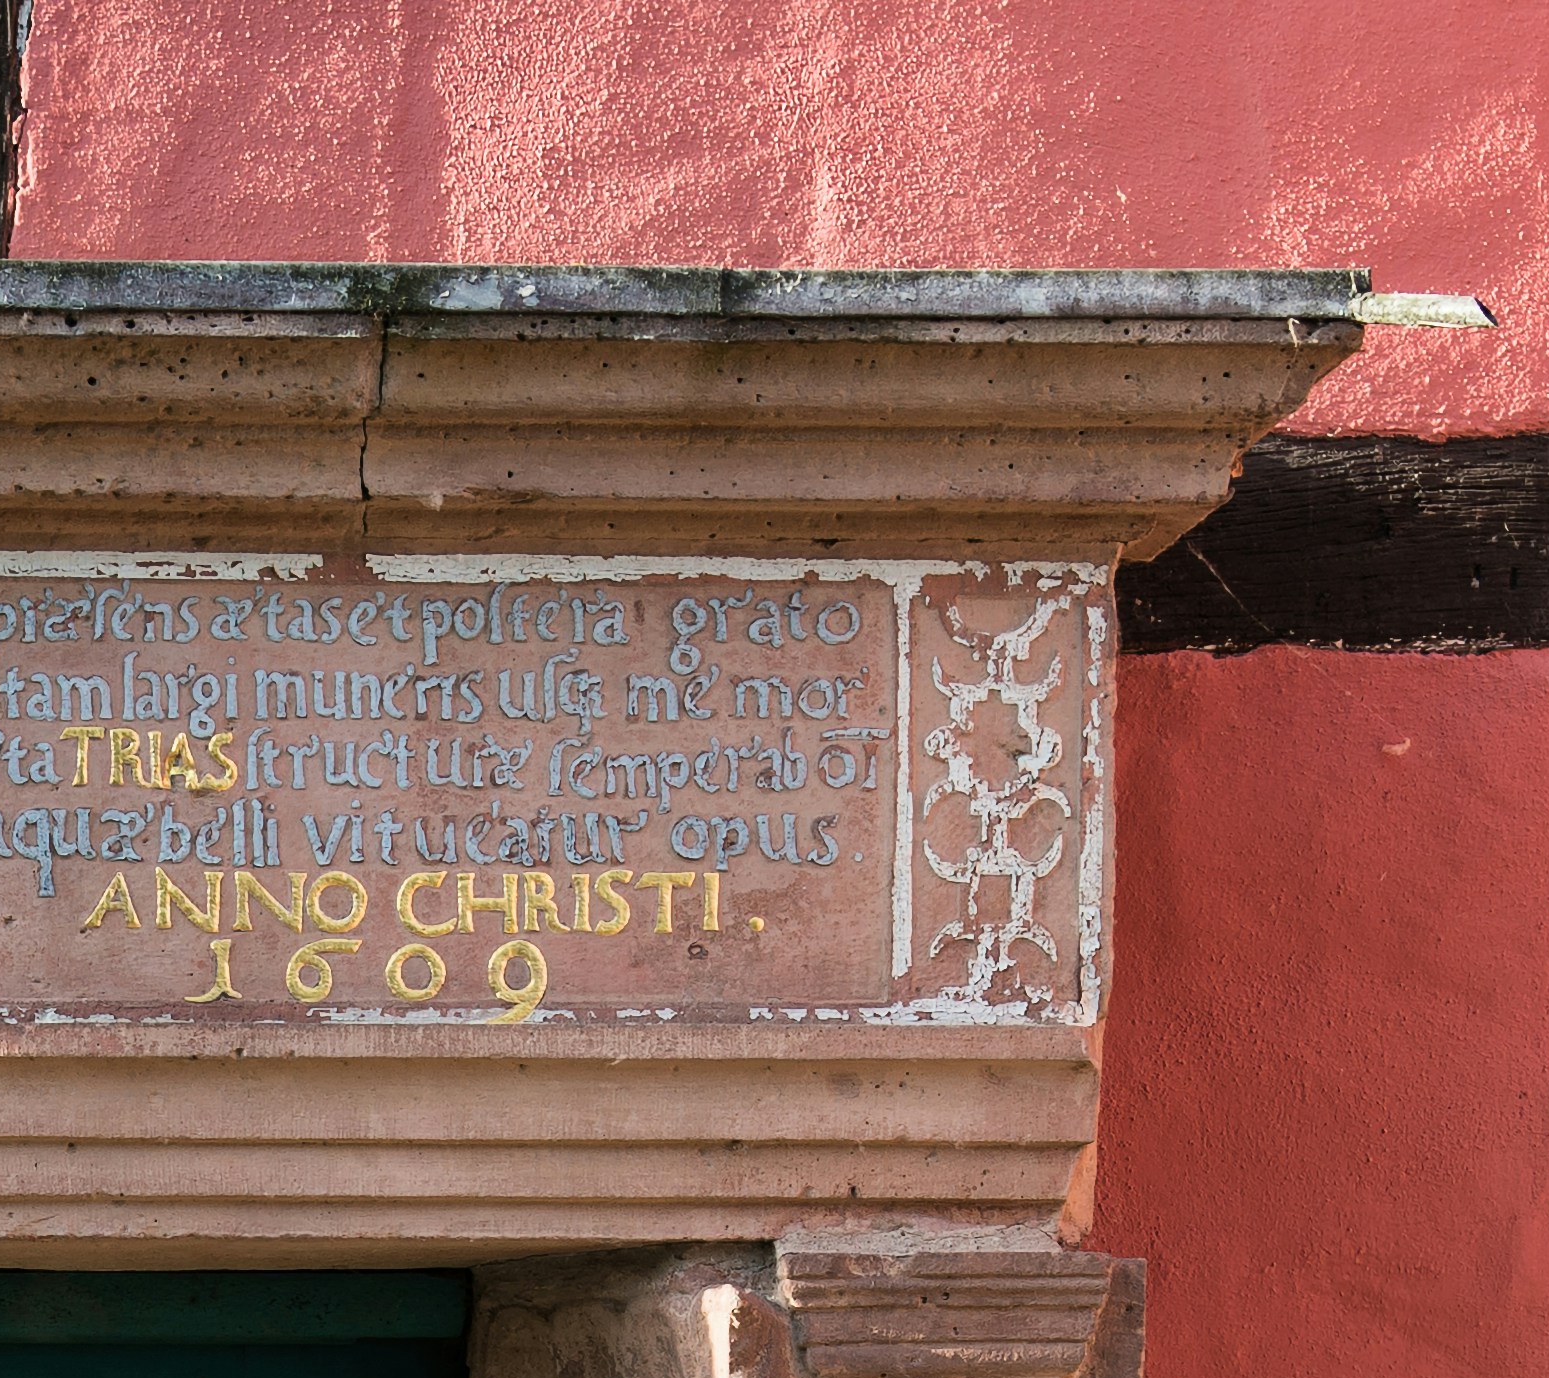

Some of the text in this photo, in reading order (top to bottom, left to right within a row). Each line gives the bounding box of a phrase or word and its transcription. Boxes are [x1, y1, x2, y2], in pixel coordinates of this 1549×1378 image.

[670, 588, 862, 676] grato
[0, 666, 114, 721] tam
[122, 650, 239, 739] largi
[60, 726, 238, 792] TRIAS
[84, 867, 369, 935] ANNO
[183, 938, 548, 1025] 1609
